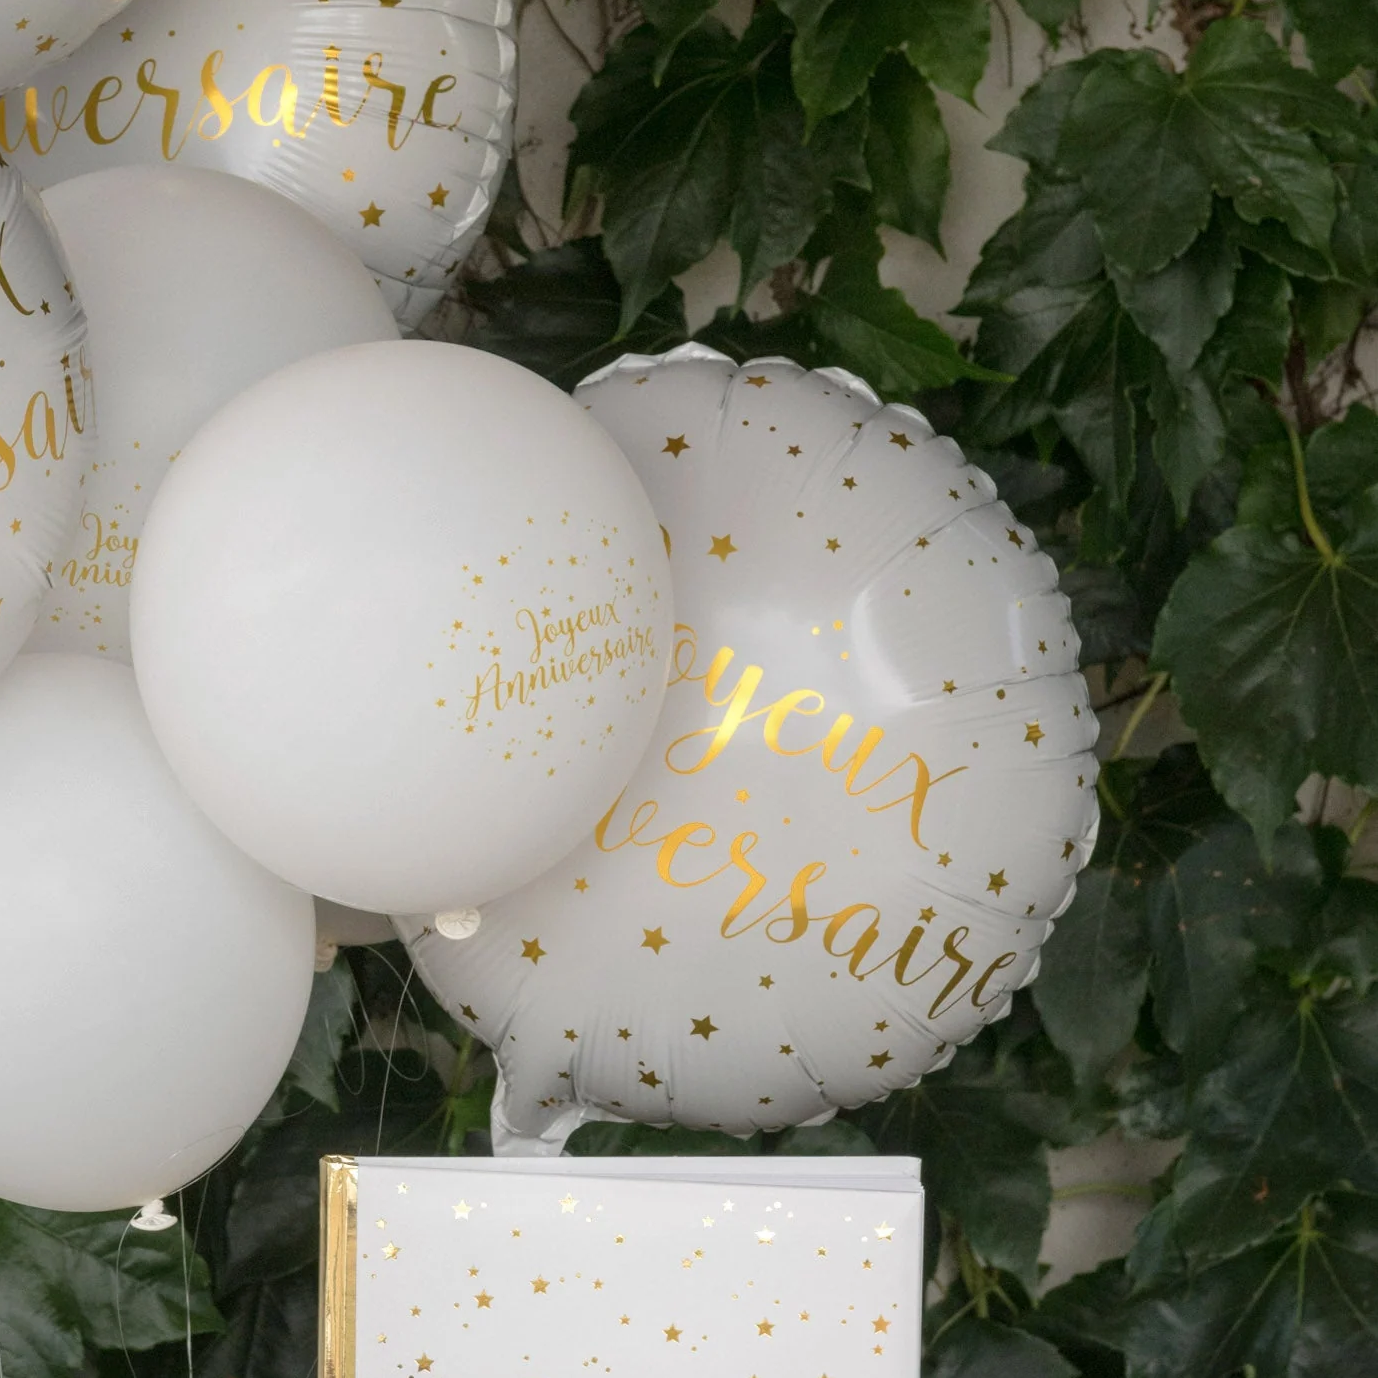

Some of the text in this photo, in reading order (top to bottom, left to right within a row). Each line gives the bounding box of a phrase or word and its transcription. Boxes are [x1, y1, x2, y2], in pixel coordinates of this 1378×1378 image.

[82, 512, 140, 569] Joy
[515, 595, 623, 664] Joyeux
[465, 625, 655, 720] Anniversaire
[594, 784, 1018, 1020] versaire
